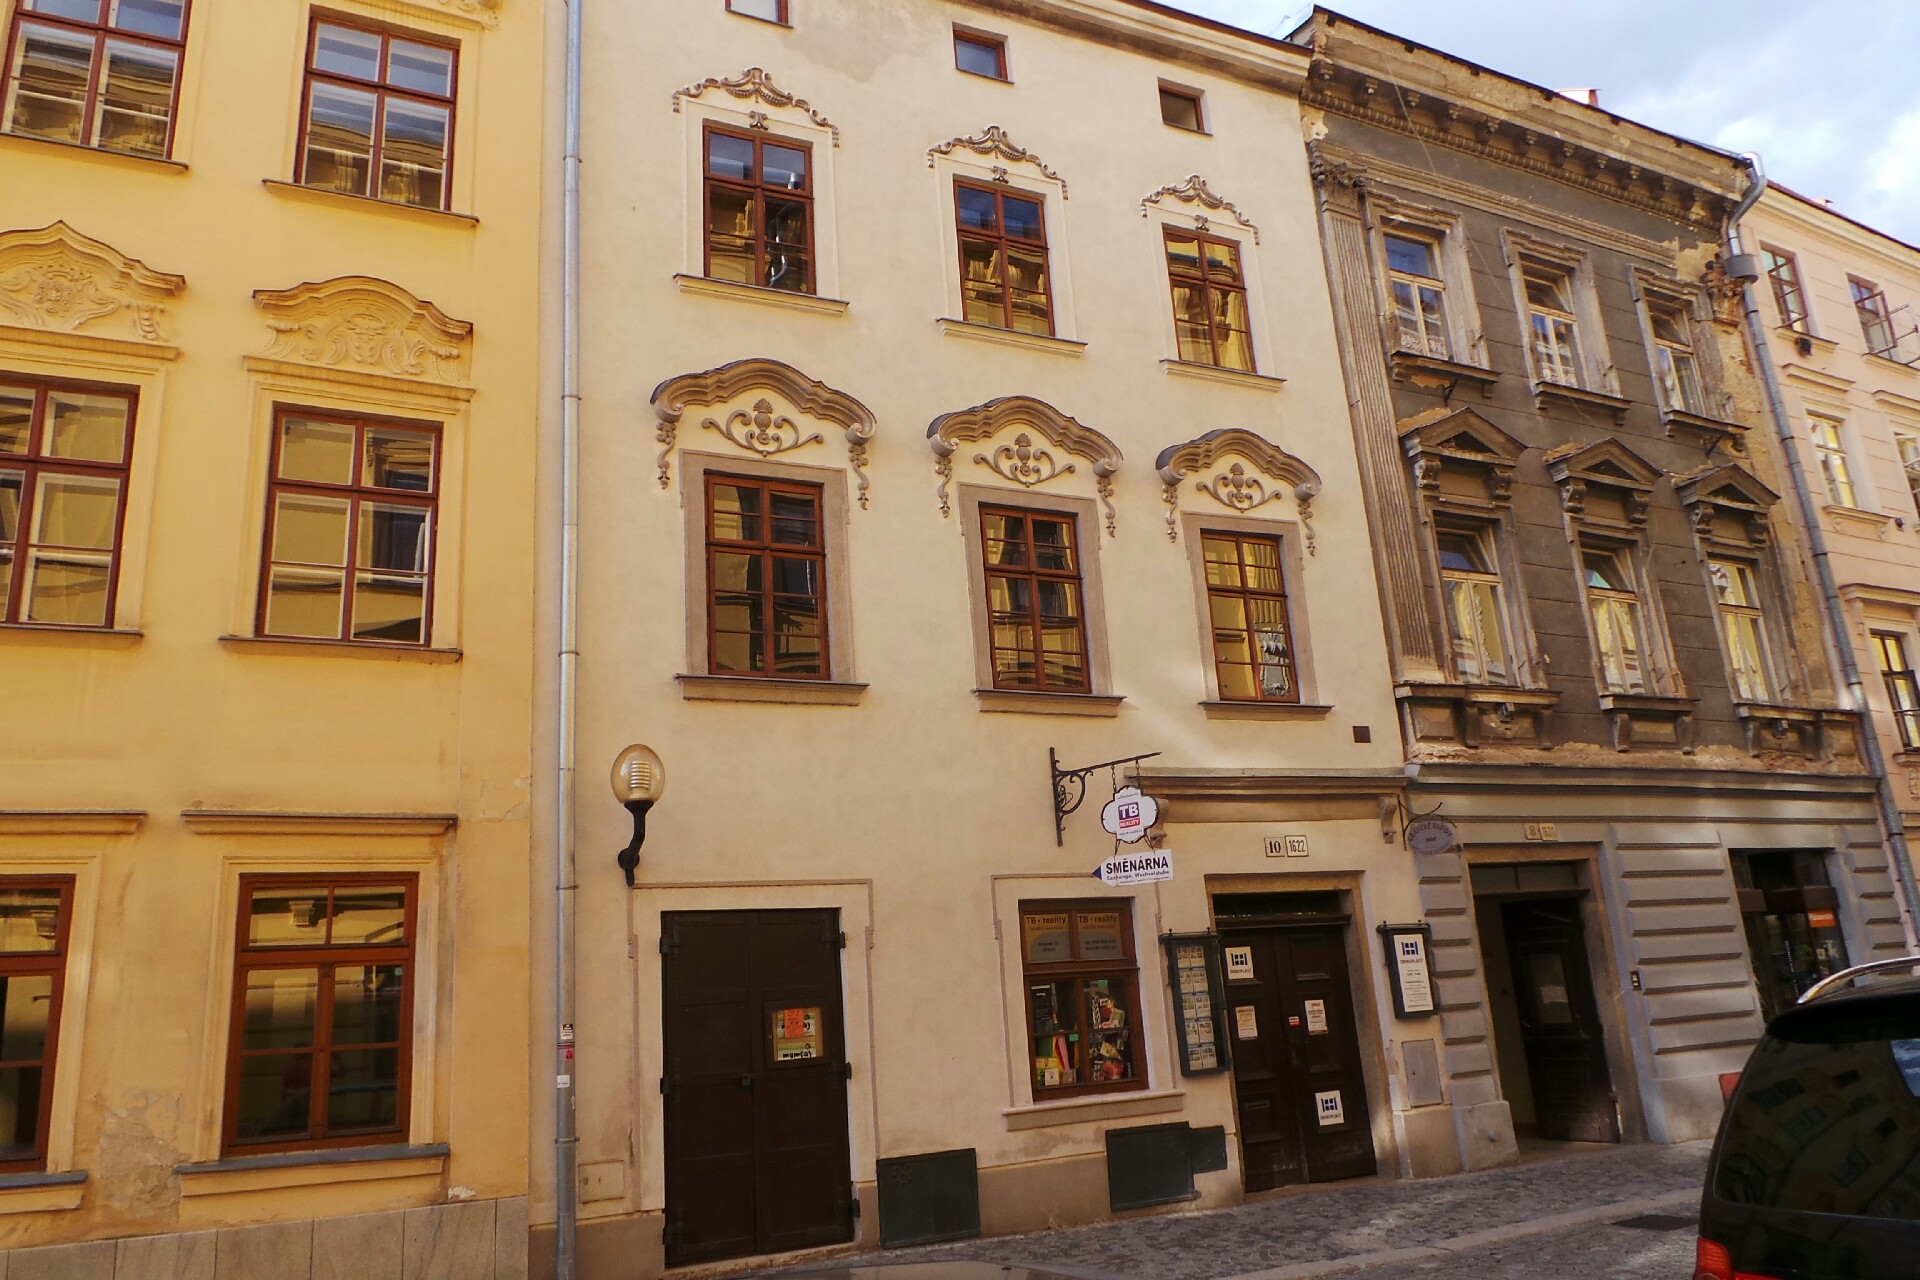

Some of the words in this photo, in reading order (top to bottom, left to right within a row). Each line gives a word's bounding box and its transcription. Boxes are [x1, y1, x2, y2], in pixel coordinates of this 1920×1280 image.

[1119, 803, 1139, 819] TB
[1120, 819, 1140, 827] REALITY
[1529, 824, 1537, 837] 8
[1268, 840, 1281, 853] 10
[1289, 840, 1306, 852] 1622
[1106, 856, 1169, 875] SMĚNÁRNA
[1135, 869, 1170, 878] Wechselstube
[1025, 916, 1036, 924] TB
[1043, 916, 1066, 924] reality
[1078, 915, 1088, 923] TB
[1094, 915, 1117, 924] reality
